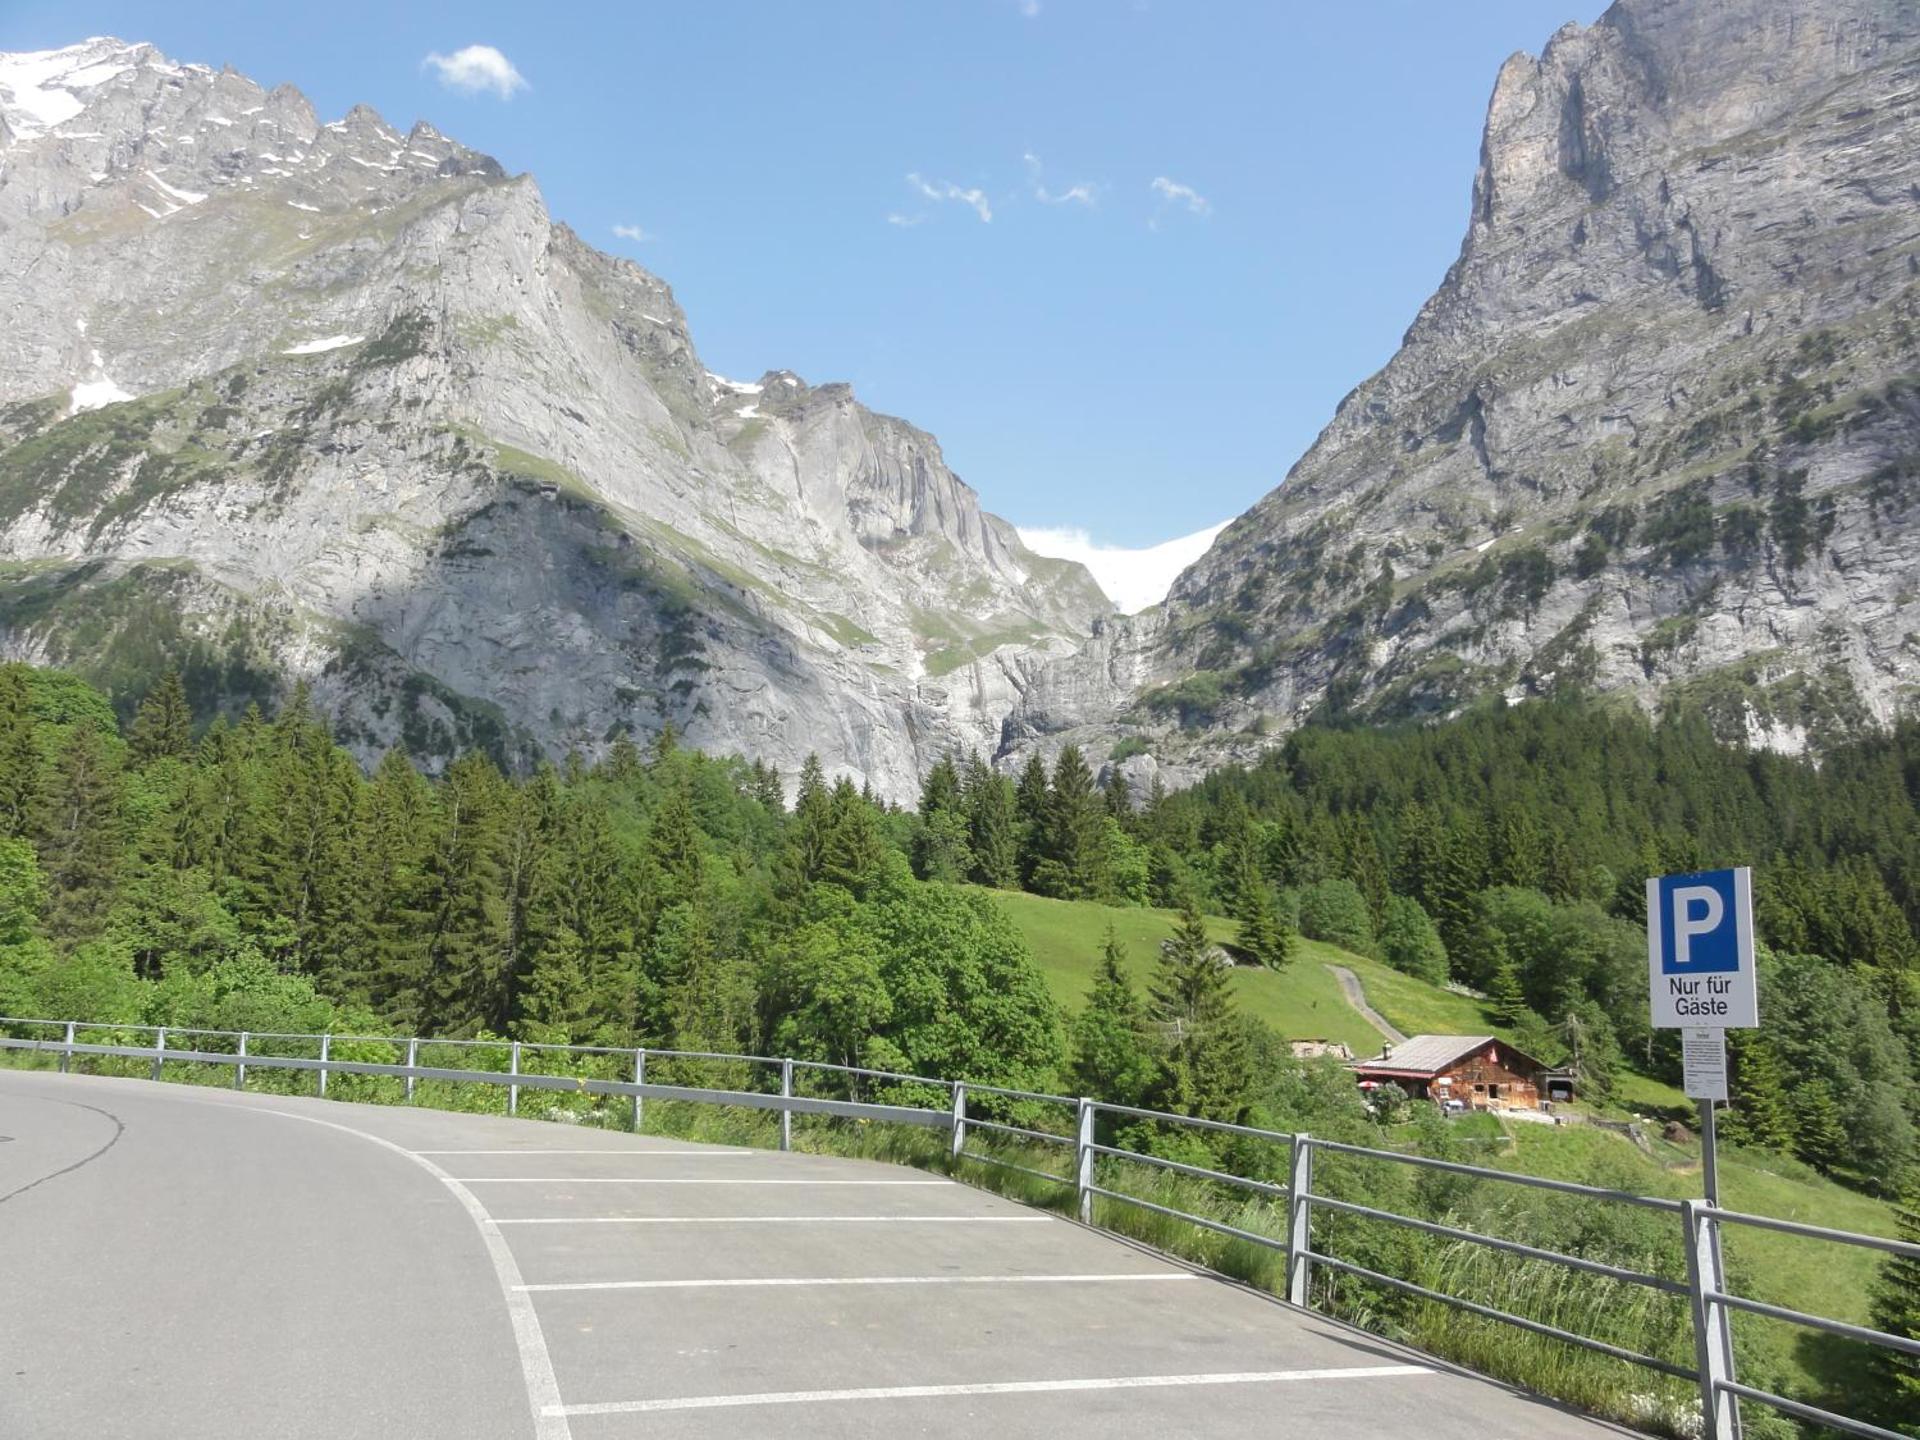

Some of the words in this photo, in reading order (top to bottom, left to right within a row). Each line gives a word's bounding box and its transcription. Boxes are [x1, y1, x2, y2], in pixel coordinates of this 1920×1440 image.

[1672, 885, 1724, 963] P
[1670, 977, 1701, 995] Nur
[1707, 976, 1731, 994] für
[1675, 997, 1728, 1016] Gäste
